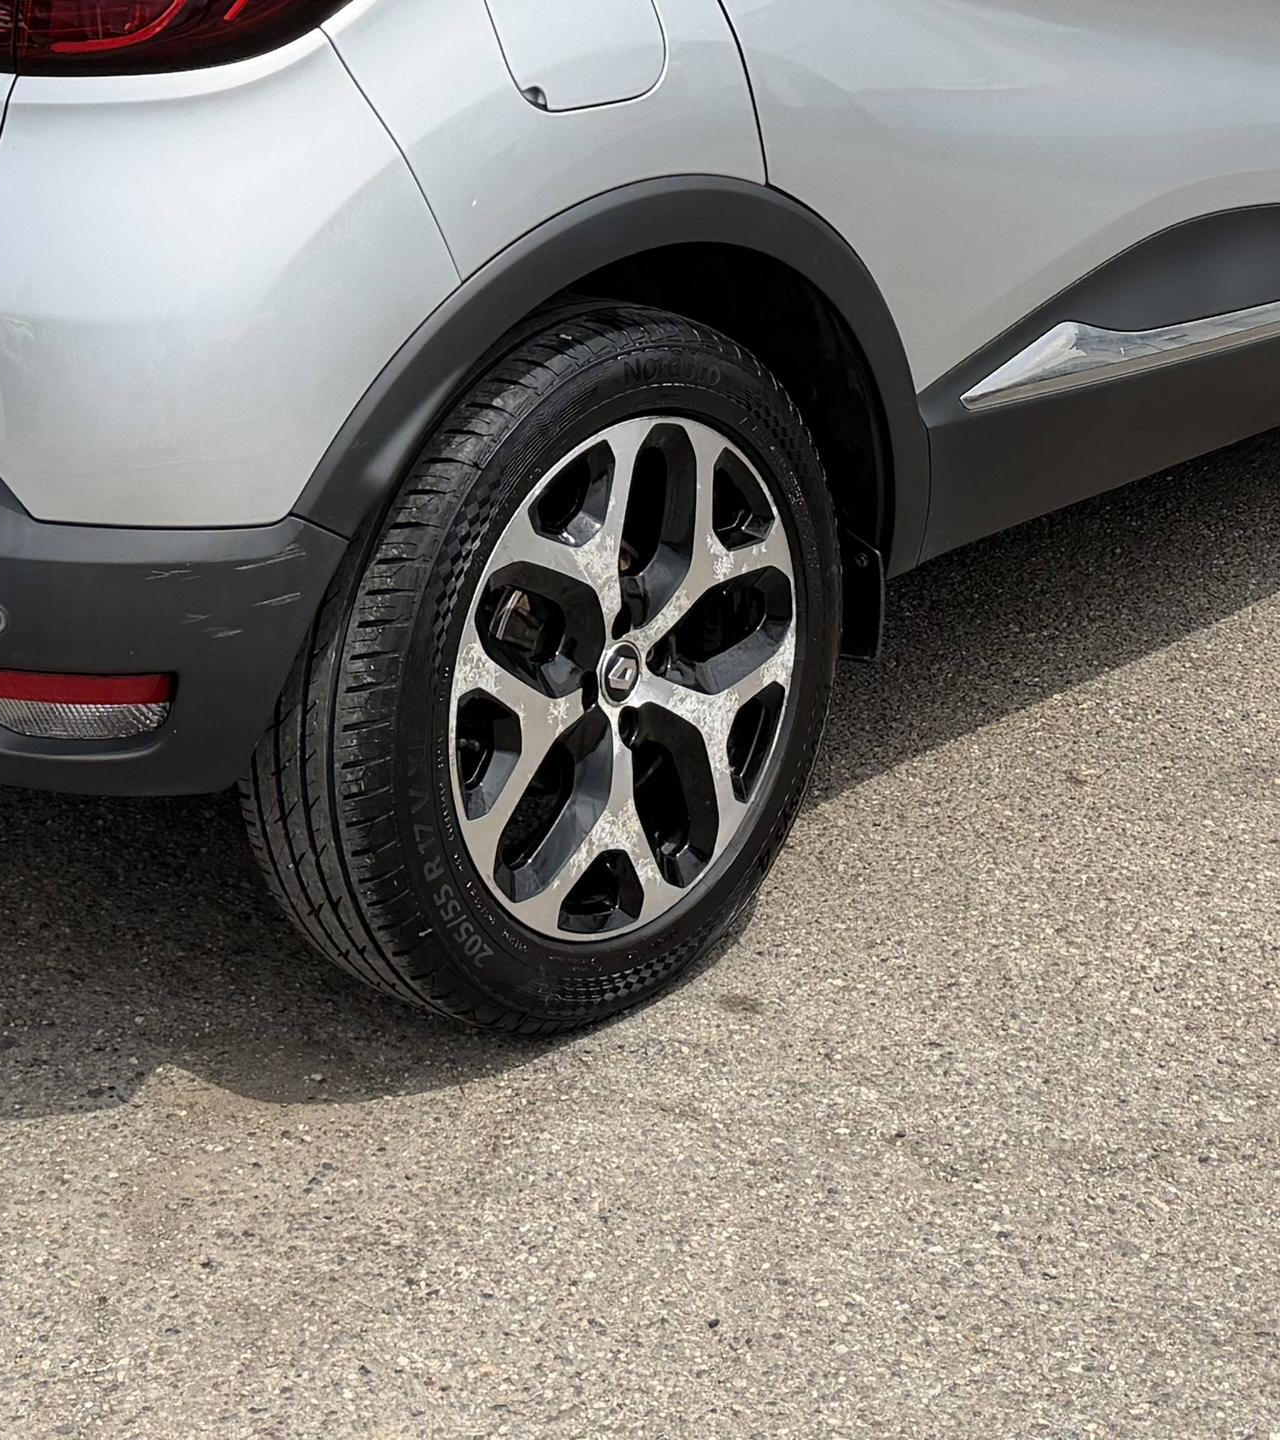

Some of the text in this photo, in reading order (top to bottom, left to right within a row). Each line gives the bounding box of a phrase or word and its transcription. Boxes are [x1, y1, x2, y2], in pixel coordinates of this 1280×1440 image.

[413, 823, 435, 855] 17
[423, 853, 445, 883] R
[432, 882, 495, 968] 205/55
